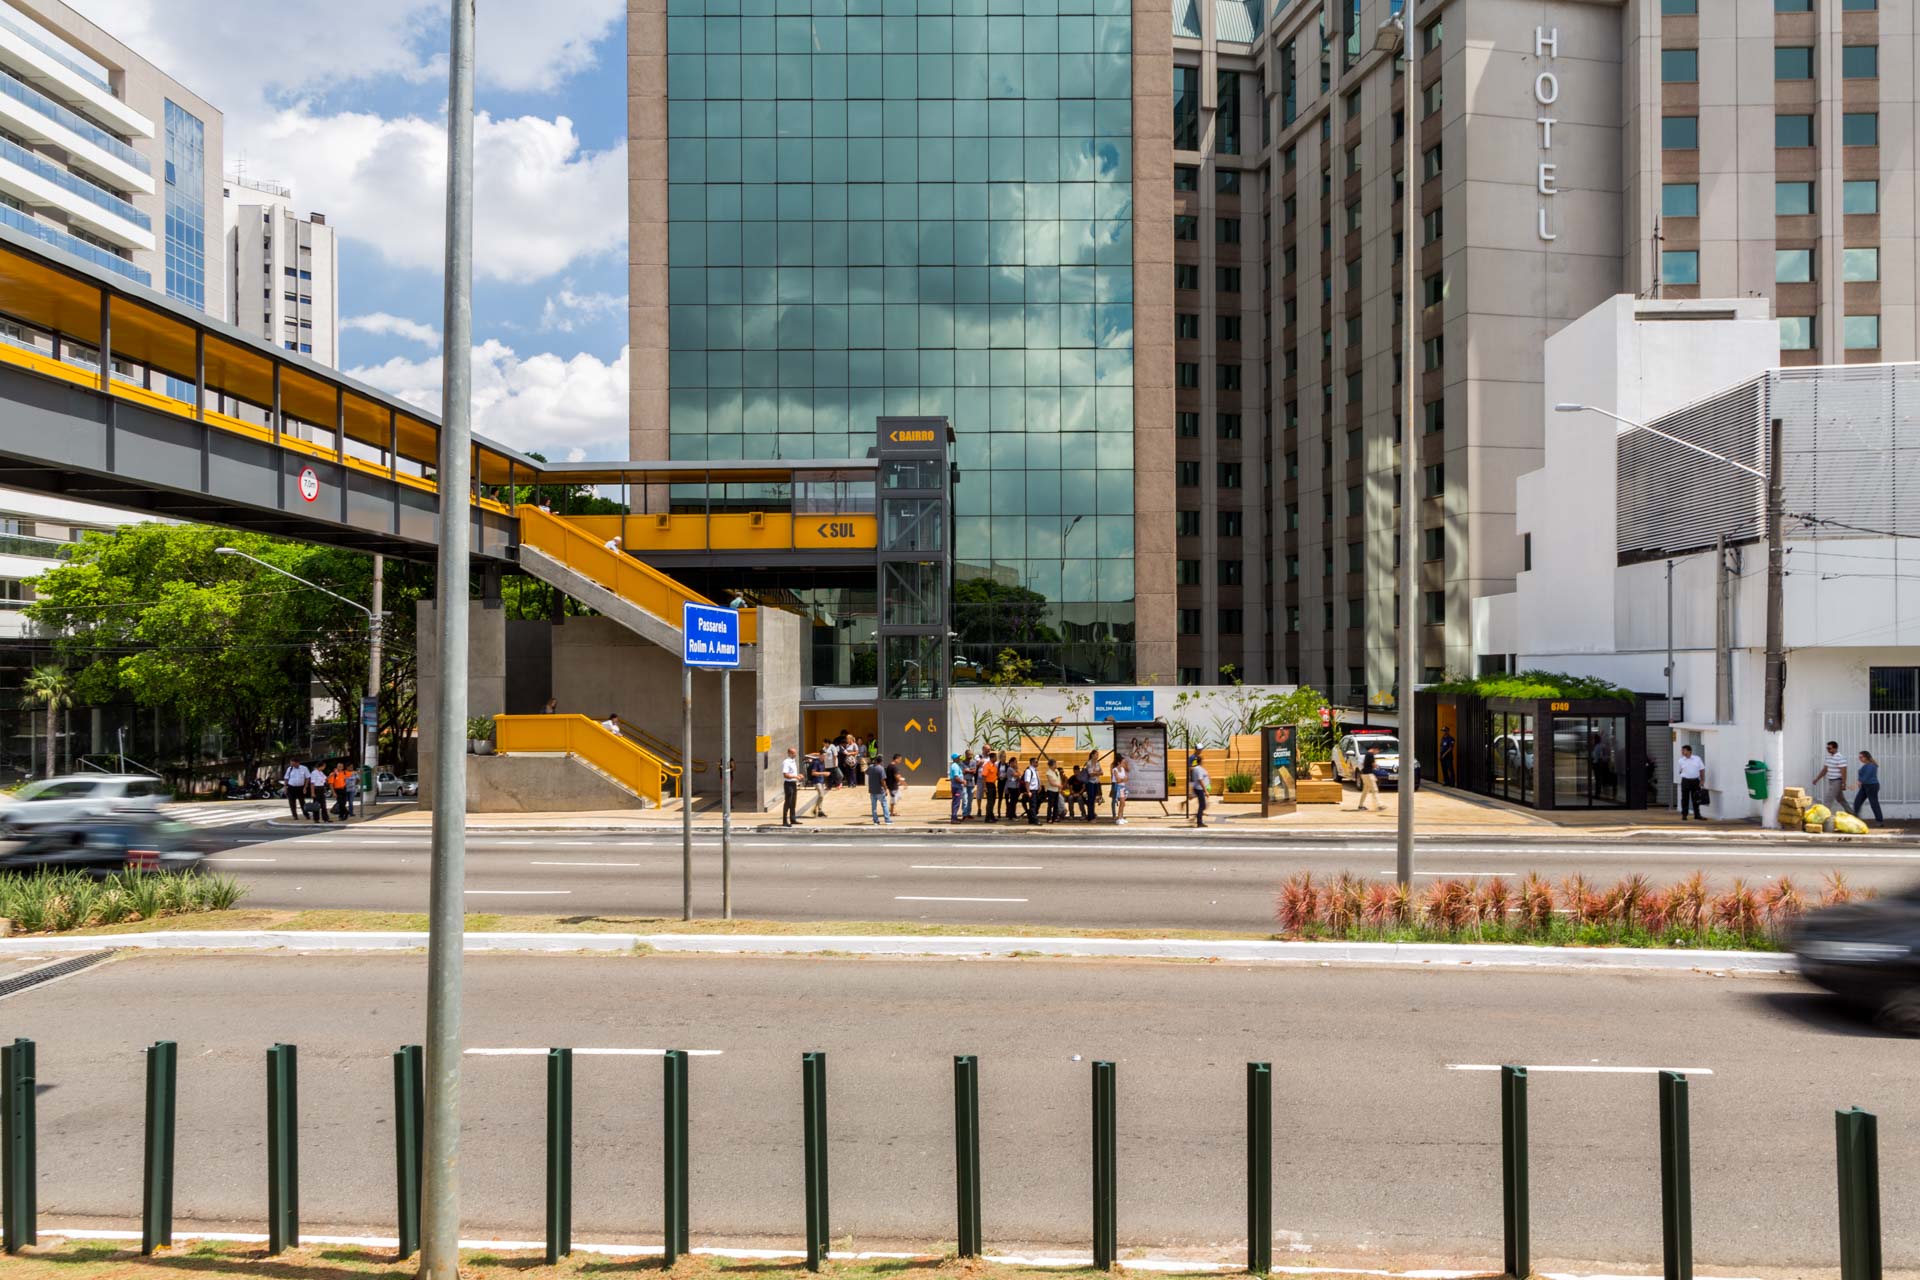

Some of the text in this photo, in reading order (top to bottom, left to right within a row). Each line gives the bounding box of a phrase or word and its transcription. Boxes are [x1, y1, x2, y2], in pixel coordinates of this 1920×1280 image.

[1535, 26, 1558, 240] HOTEL
[899, 430, 935, 442] BAIRRO
[830, 523, 855, 538] SUL
[698, 617, 727, 634] Passarela
[689, 638, 735, 655] Rolim A. Amaro
